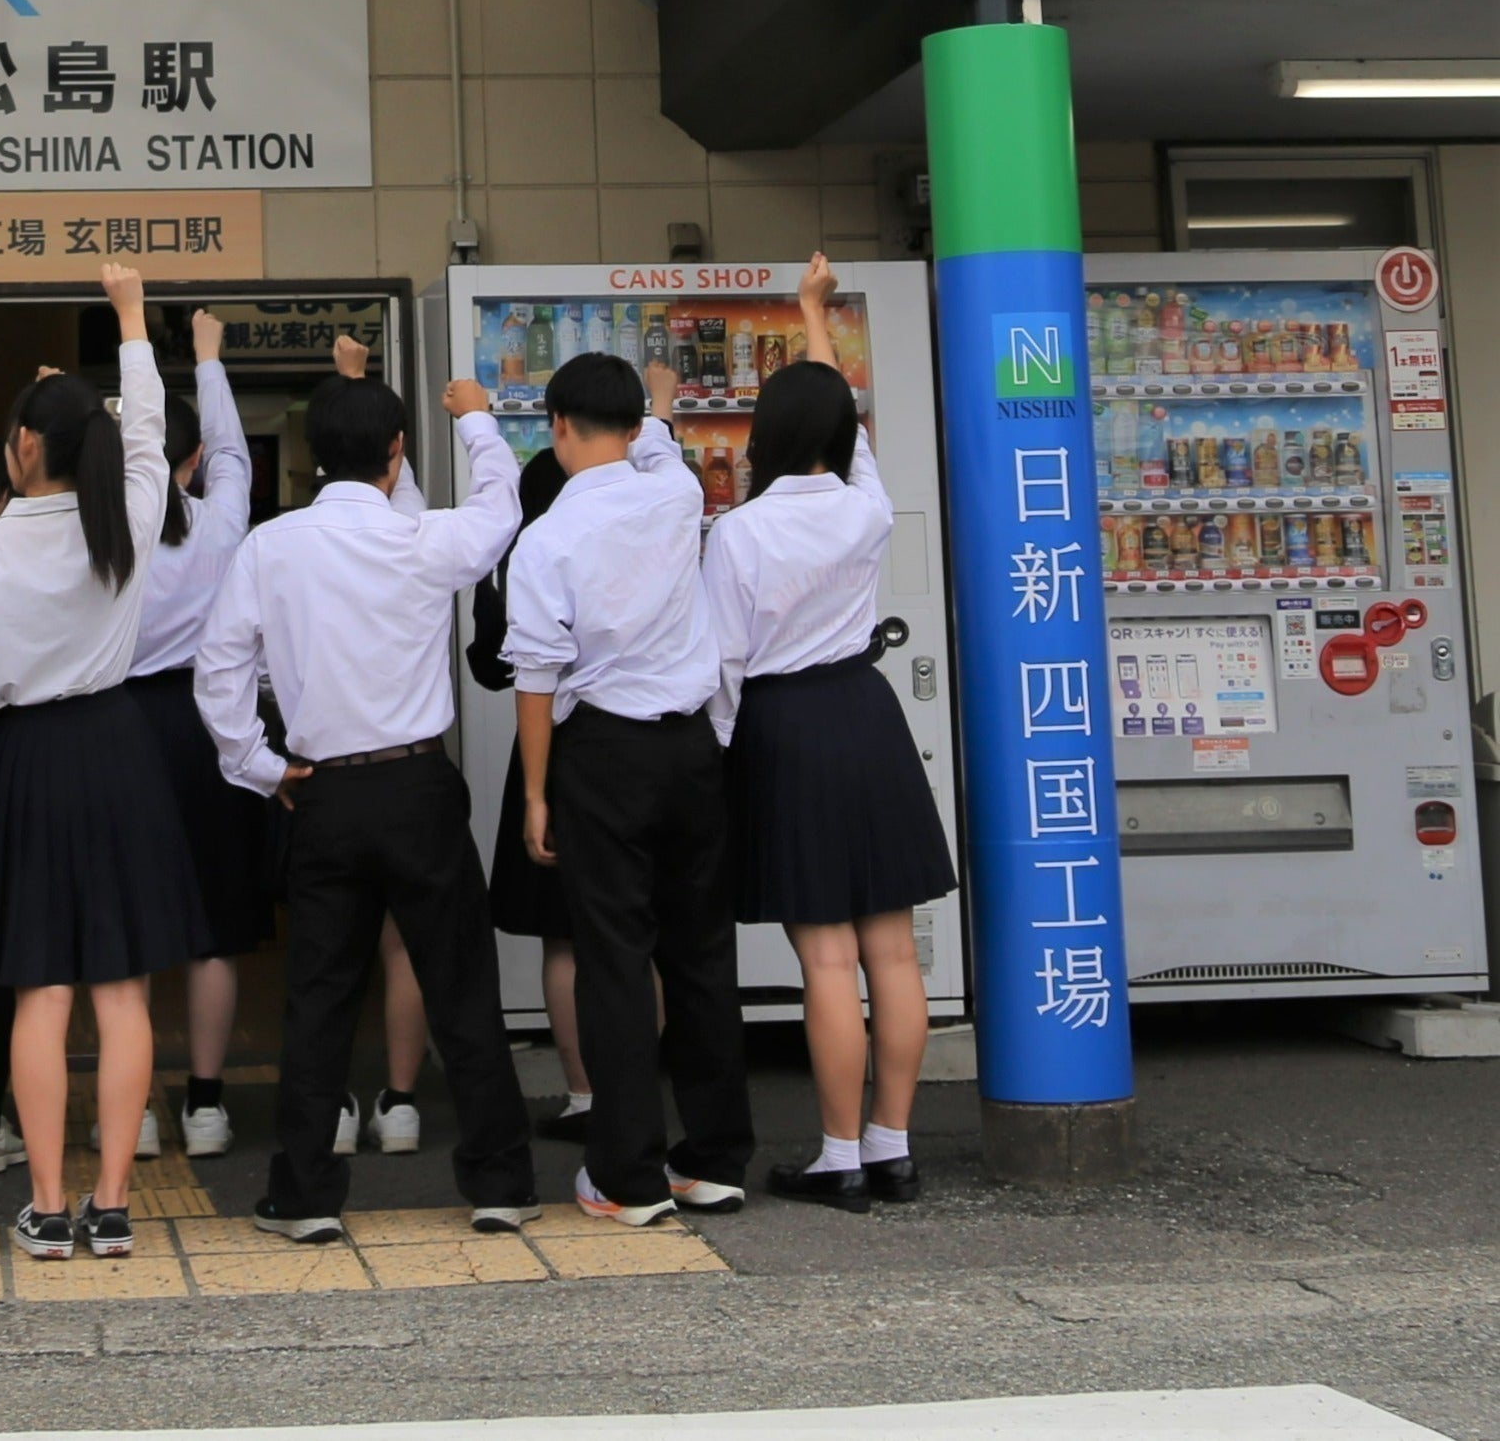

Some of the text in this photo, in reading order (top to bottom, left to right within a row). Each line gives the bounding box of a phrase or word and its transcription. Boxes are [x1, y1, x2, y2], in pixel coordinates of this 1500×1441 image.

[147, 133, 314, 171] STATION
[65, 217, 223, 256] 玄関口駅
[610, 268, 772, 289] CANS SHOP
[1011, 327, 1061, 385] N
[997, 400, 1076, 420] NISSHIN
[1010, 447, 1112, 1029] 日新四国工場
